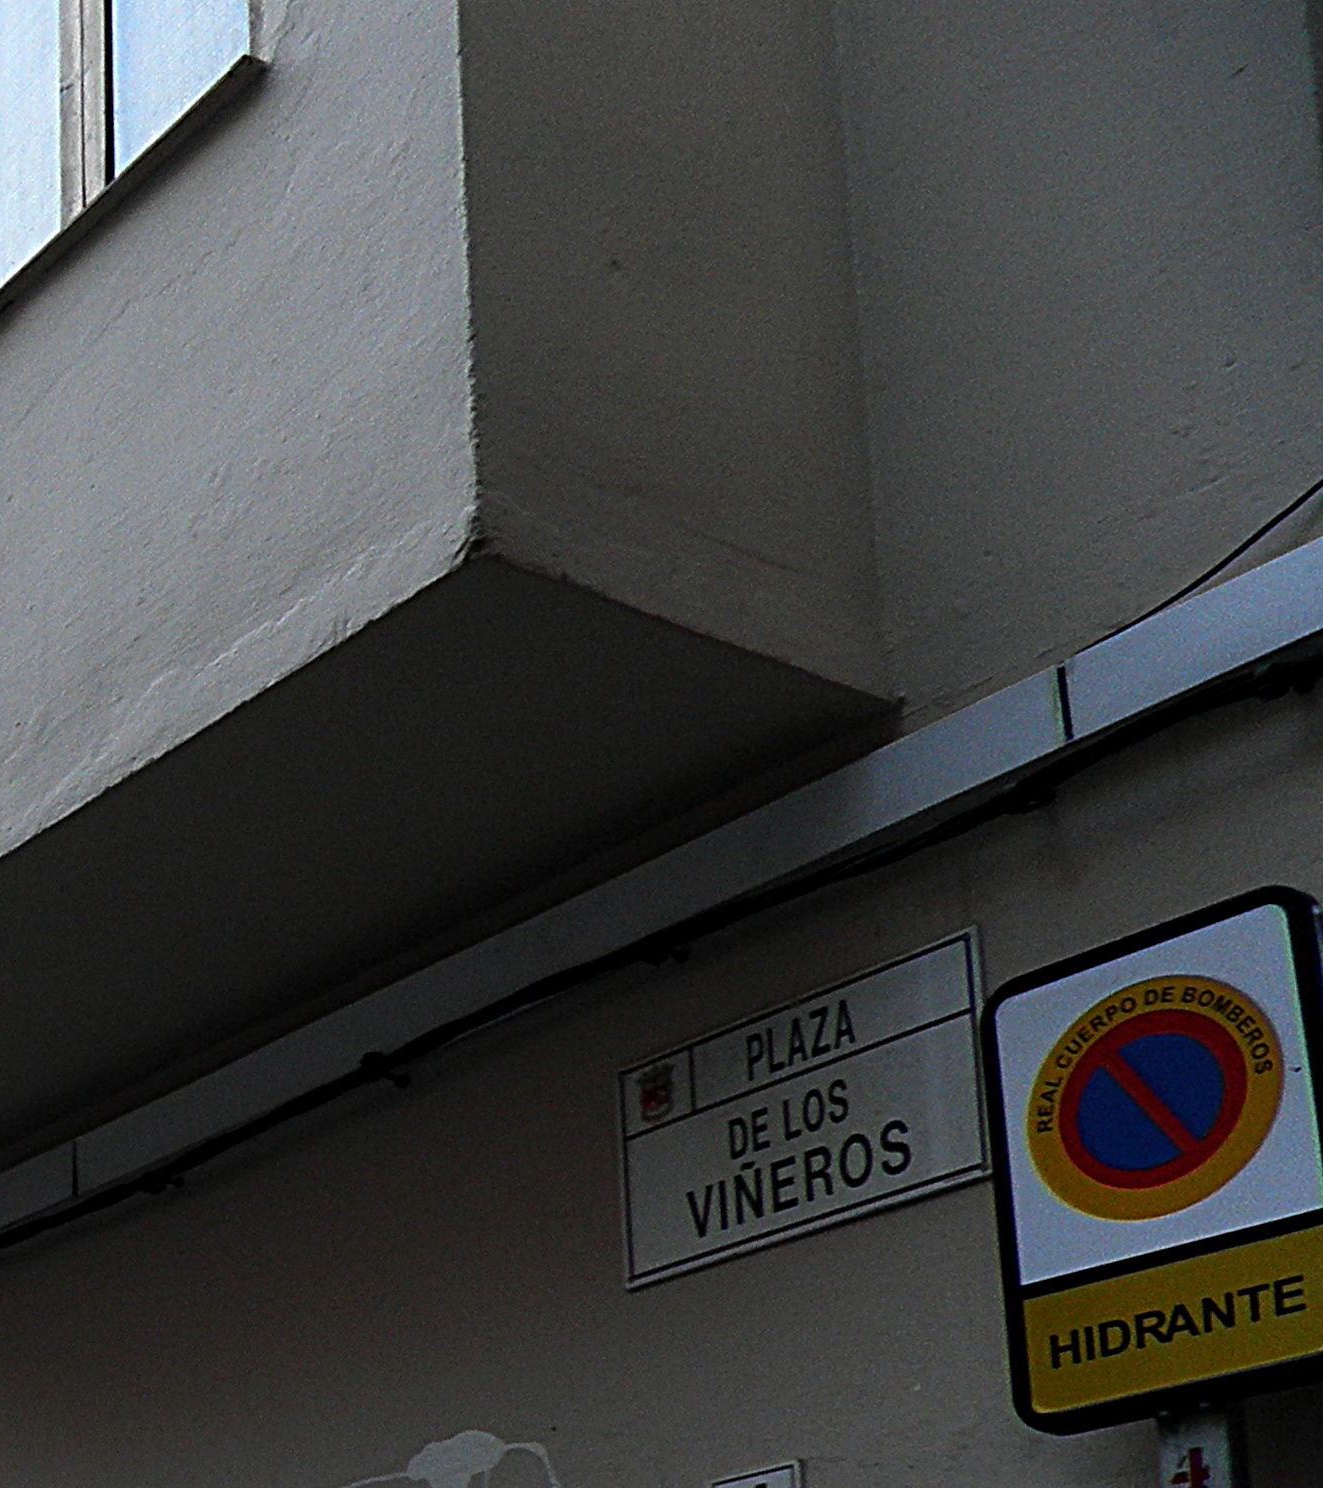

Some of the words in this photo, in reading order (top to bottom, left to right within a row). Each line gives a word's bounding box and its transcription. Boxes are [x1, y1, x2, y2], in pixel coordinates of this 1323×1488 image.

[746, 999, 856, 1082] PLAZA
[1036, 1075, 1064, 1134] REAL
[1057, 996, 1137, 1070] CUERPO
[1144, 986, 1176, 1006] DE
[1181, 986, 1274, 1076] BOMBEROS
[728, 1107, 771, 1161] DE
[782, 1078, 850, 1133] LOS
[686, 1119, 913, 1239] VIÑEROS
[1048, 1275, 1308, 1369] HIDRANTE
